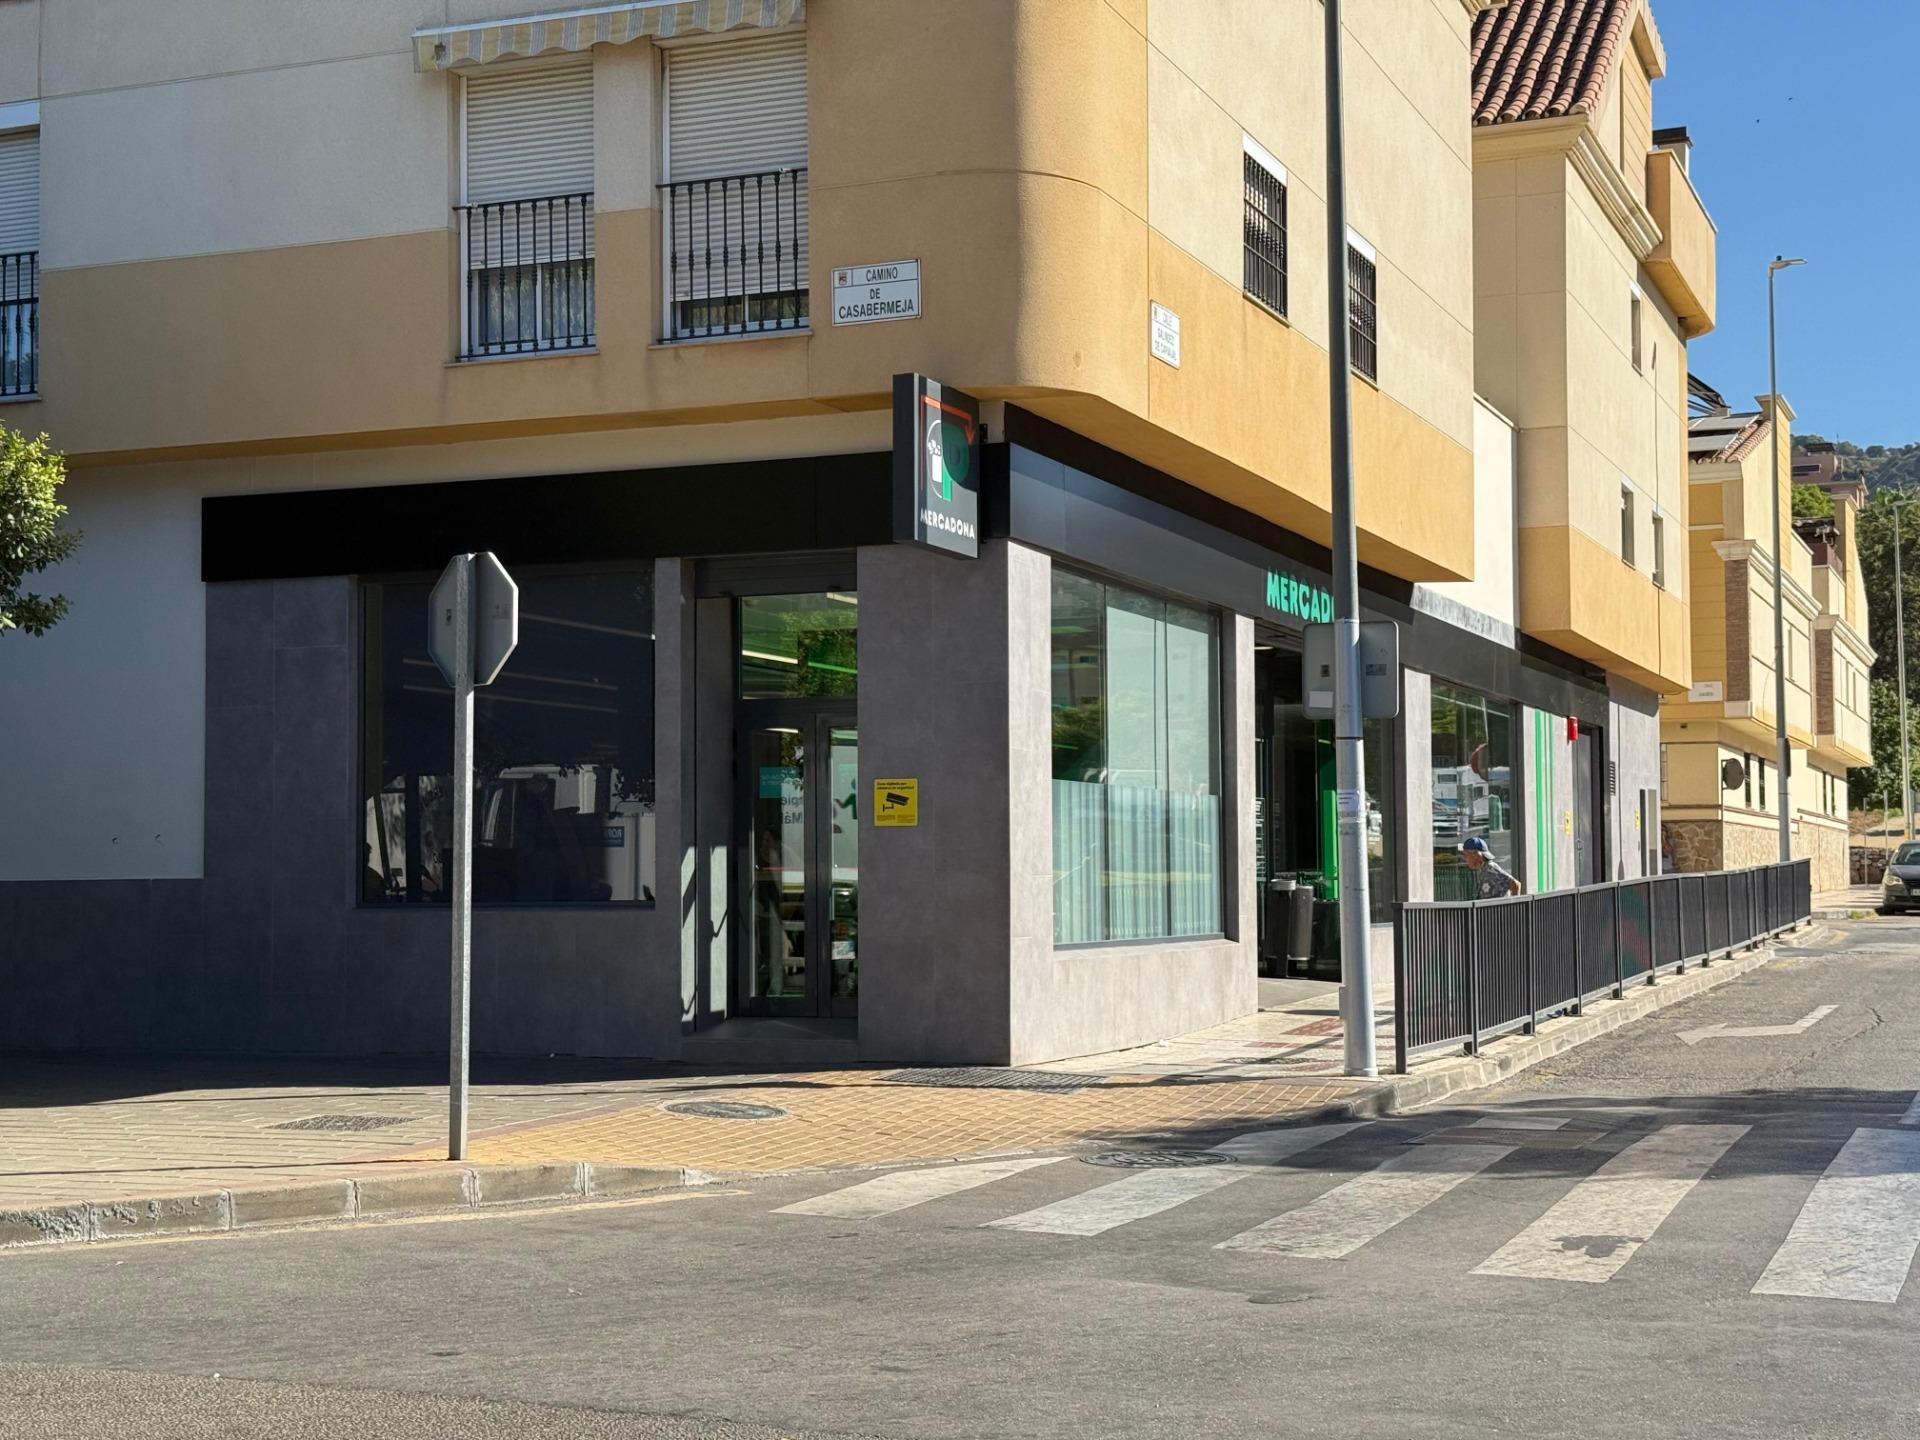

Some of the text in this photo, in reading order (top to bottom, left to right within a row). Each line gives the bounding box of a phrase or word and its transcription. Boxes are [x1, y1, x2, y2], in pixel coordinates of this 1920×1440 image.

[866, 267, 898, 282] CAMINO
[870, 288, 881, 300] DE
[839, 299, 914, 319] CASABERMEJA
[920, 508, 975, 540] MERCADONA
[1266, 571, 1335, 624] MERCAD
